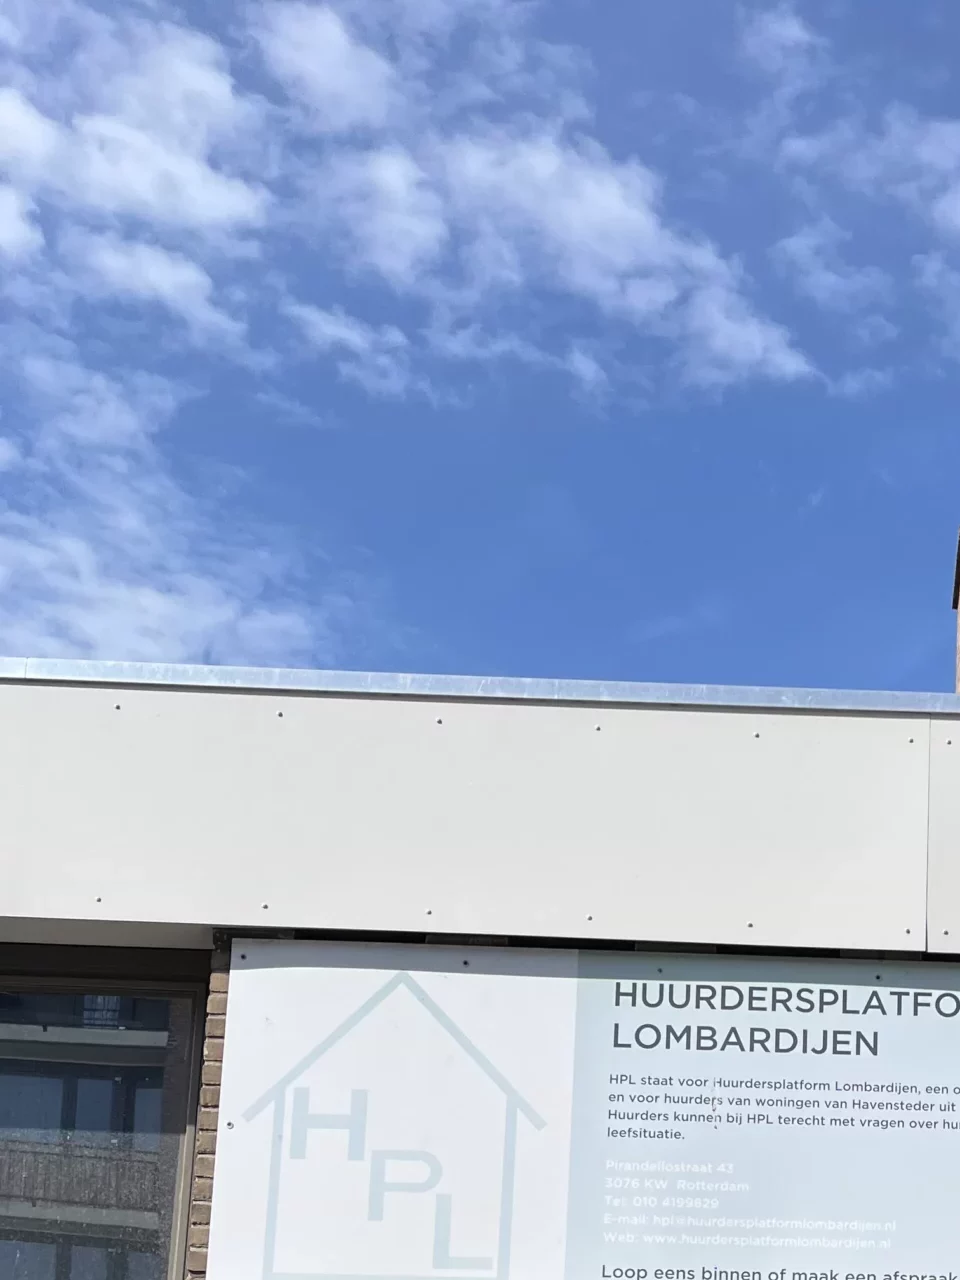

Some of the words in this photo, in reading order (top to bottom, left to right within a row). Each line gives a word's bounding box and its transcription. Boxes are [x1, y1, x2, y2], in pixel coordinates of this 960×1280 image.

[612, 1022, 879, 1057] LOMBARDIJEN
[609, 1073, 637, 1085] HPL
[640, 1075, 674, 1087] staat
[677, 1077, 709, 1087] voor
[713, 1077, 831, 1091] Huurdersplatform
[835, 1081, 921, 1095] Lombardijen,
[925, 1085, 949, 1095] een
[608, 1093, 625, 1103] en
[628, 1093, 660, 1104] voor
[664, 1093, 723, 1105] huurders
[727, 1097, 751, 1106] van
[755, 1096, 820, 1109] woningen
[824, 1100, 848, 1109] van
[852, 1099, 935, 1111] Havensteder
[939, 1102, 956, 1112] uit
[608, 1109, 669, 1122] Huurders
[673, 1111, 722, 1123] kunnen
[726, 1112, 743, 1125] bij
[746, 1113, 774, 1125] HPL
[777, 1114, 826, 1126] terecht
[829, 1116, 855, 1127] met
[859, 1118, 905, 1130] vragen
[908, 1119, 939, 1129] over
[607, 1127, 685, 1140] leefsituatie.
[715, 1163, 734, 1174] 43
[644, 1178, 668, 1190] KW
[676, 1179, 750, 1192] Rotterdam
[632, 1196, 658, 1208] 010
[653, 1267, 696, 1280] eens
